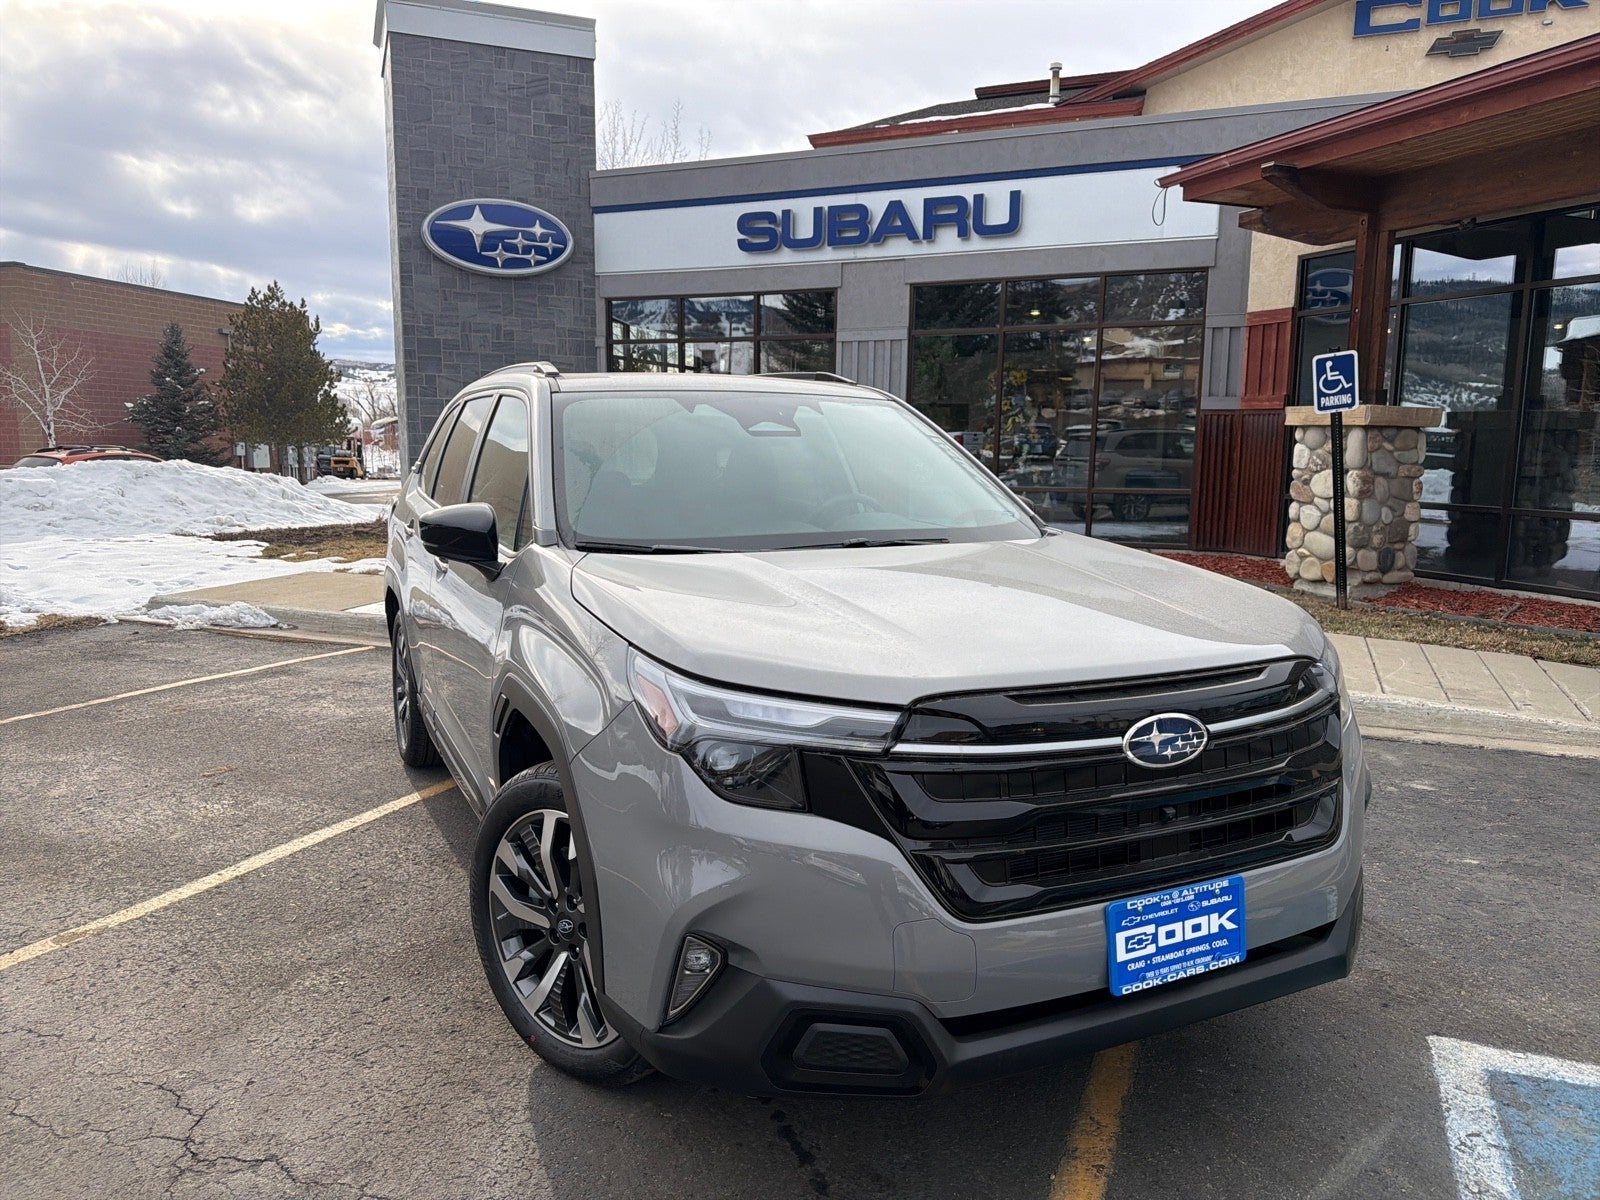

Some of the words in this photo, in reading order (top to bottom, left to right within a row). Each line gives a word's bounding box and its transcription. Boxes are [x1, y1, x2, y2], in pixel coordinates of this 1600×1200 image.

[737, 189, 1022, 253] SUBARU
[1321, 394, 1352, 407] PARKING
[1182, 880, 1229, 896] ALTITUDE
[1202, 895, 1232, 907] SUBARU
[1142, 908, 1178, 921] CHEVROLET
[1116, 908, 1238, 962] COOK
[1127, 959, 1146, 971] CRAIG
[1151, 949, 1185, 965] STEAMBOAT
[1185, 942, 1211, 956] SPRINGS,
[1211, 938, 1229, 948] COLO.
[1122, 956, 1240, 995] COOK-CARS.COM
